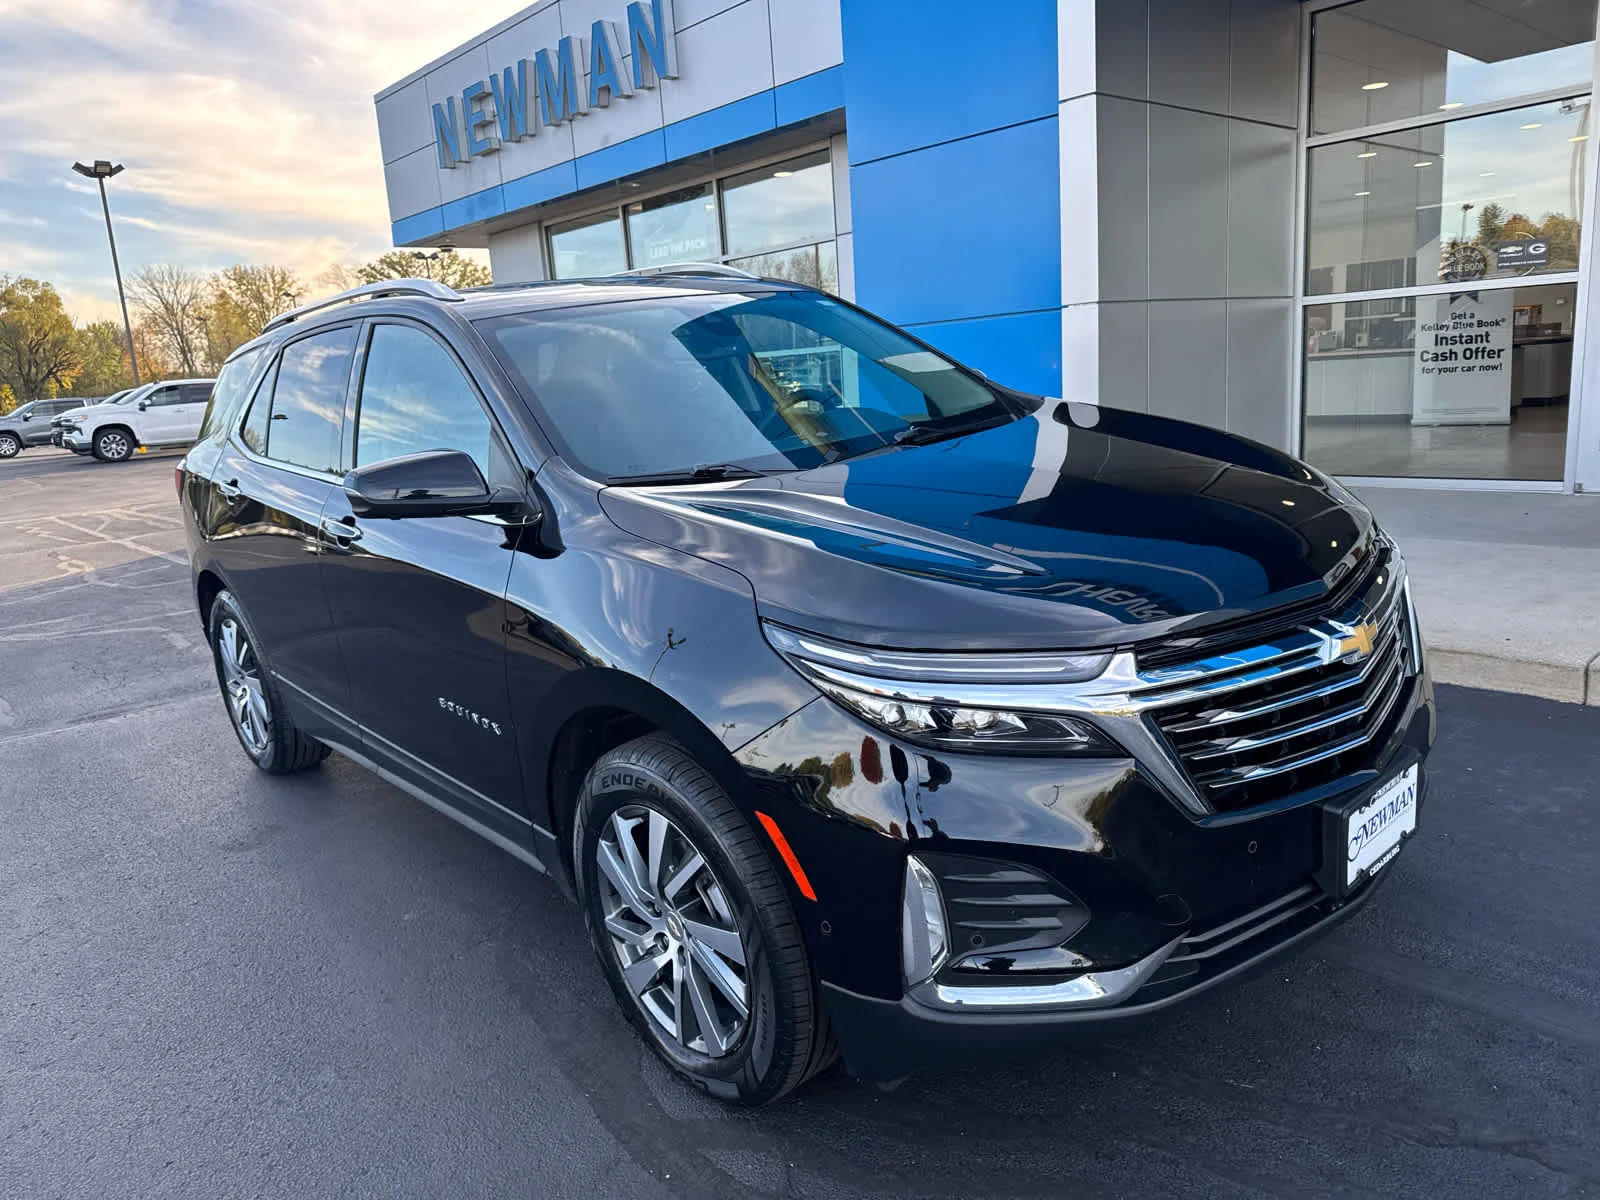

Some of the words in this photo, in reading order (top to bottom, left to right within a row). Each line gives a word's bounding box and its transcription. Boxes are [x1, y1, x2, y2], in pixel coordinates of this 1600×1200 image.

[431, 0, 679, 169] NEWMAN
[1528, 243, 1547, 254] G
[1450, 311, 1467, 320] Get
[1421, 323, 1450, 332] Kelley
[1452, 321, 1474, 330] Blue
[1434, 331, 1491, 347] Instant
[1420, 348, 1458, 362] Cash
[1462, 346, 1505, 360] Offer
[1422, 366, 1435, 374] for
[1437, 366, 1459, 375] your
[1461, 365, 1476, 373] car
[1479, 362, 1503, 371] now!
[437, 696, 502, 736] EQUINOX
[1348, 783, 1416, 861] NEWMAN
